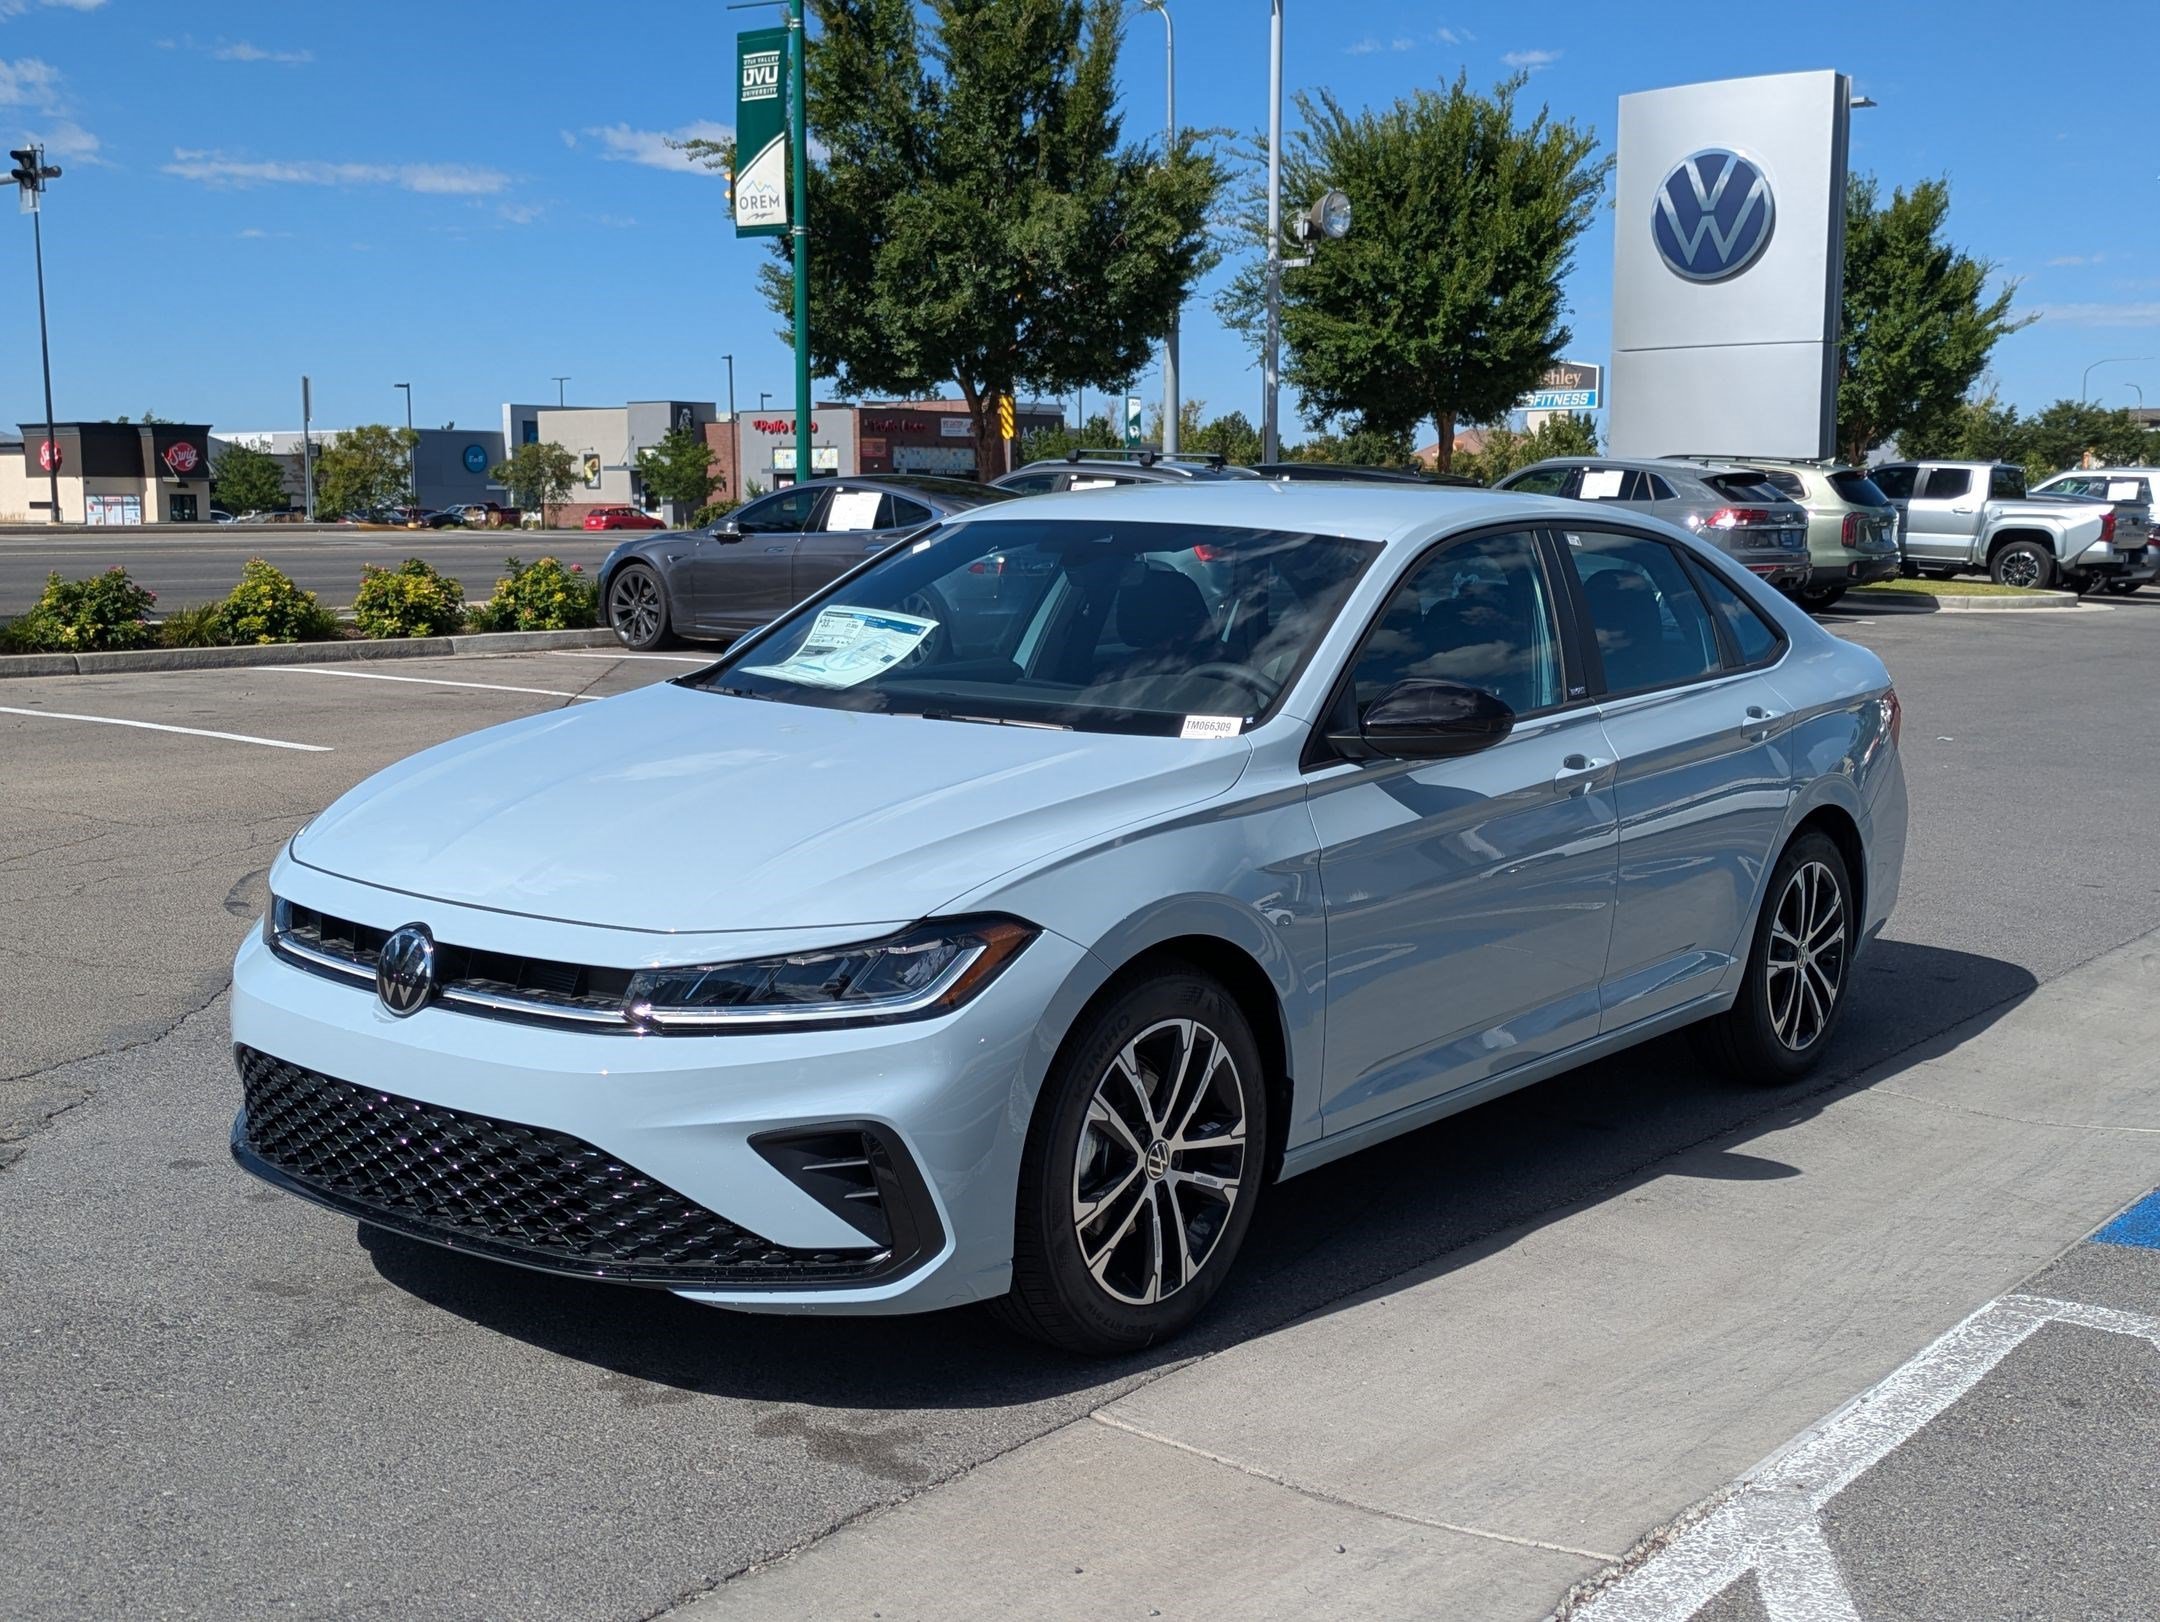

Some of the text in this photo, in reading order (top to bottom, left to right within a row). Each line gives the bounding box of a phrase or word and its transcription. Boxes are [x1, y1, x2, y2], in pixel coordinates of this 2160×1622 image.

[757, 55, 779, 63] VALLEY
[743, 66, 779, 86] UVU
[742, 87, 778, 97] UNIVERSITY
[739, 194, 780, 210] OREM
[1540, 368, 1582, 389] shley
[168, 446, 198, 467] Swig
[1185, 720, 1232, 732] TM066309
